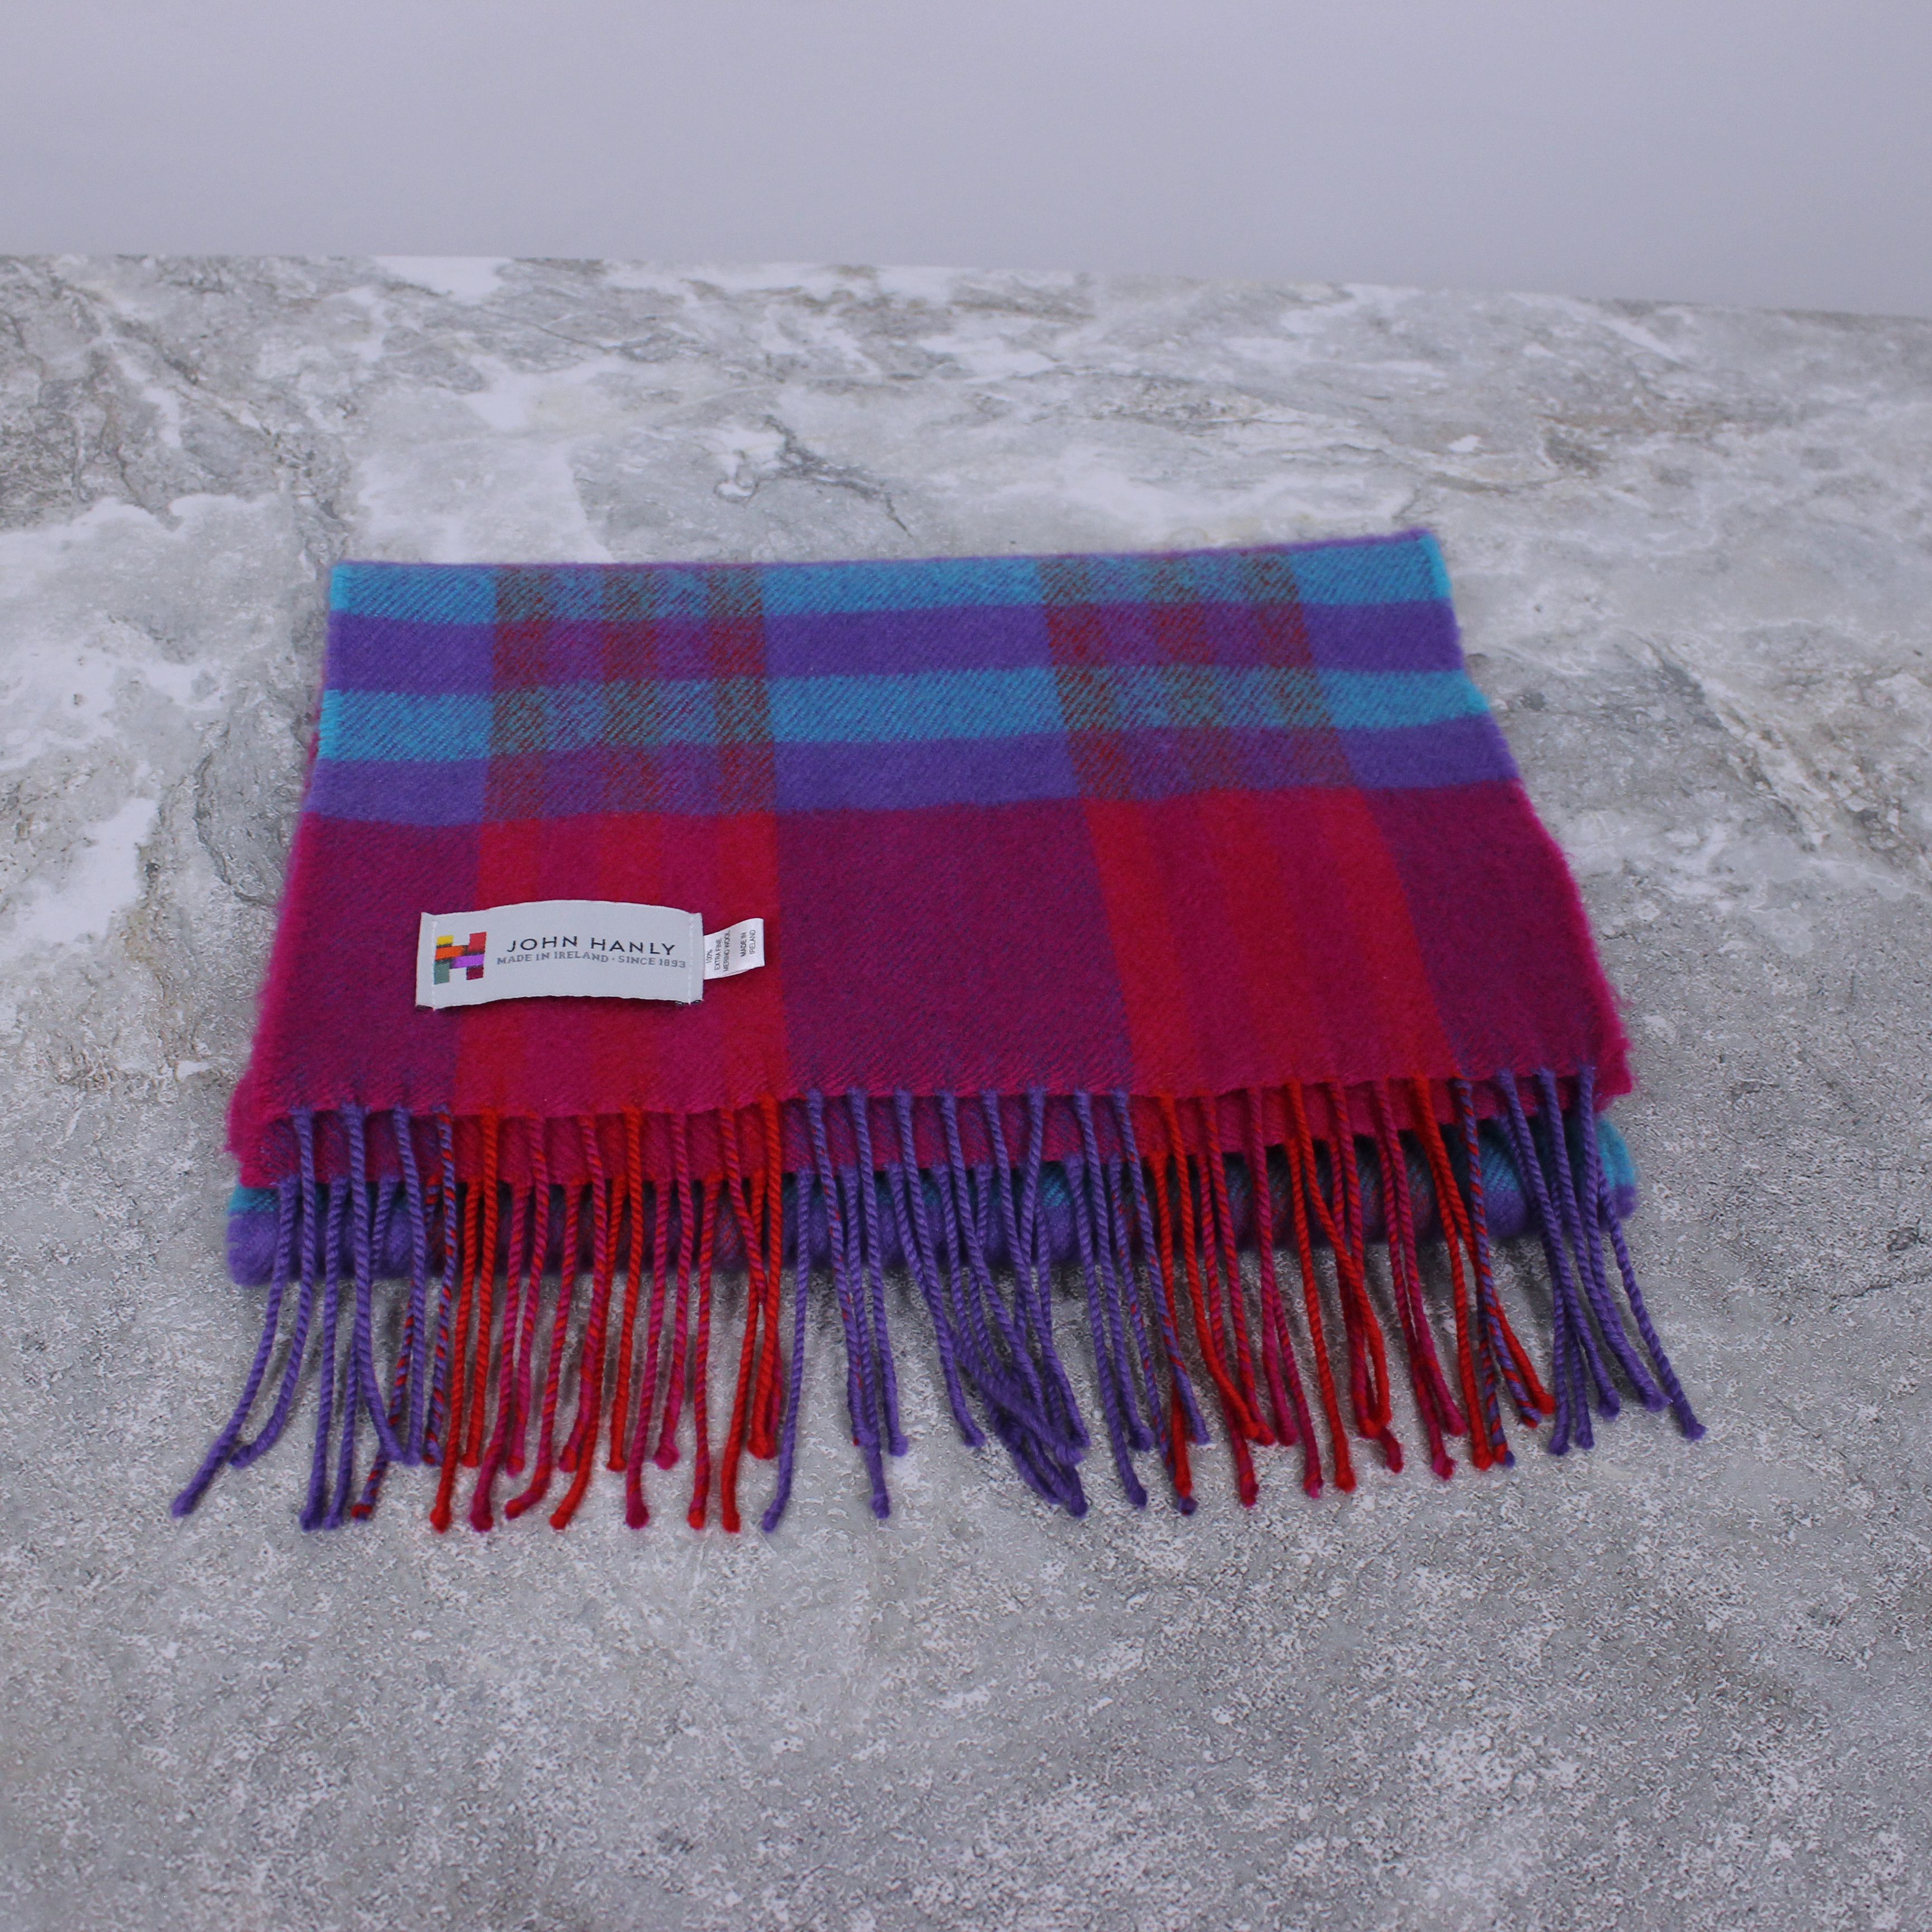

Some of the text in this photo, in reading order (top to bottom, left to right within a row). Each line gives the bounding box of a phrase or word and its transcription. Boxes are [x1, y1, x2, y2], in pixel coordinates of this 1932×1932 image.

[506, 936, 675, 955] JOHN HANLY
[497, 954, 533, 965] MADE
[554, 951, 609, 963] IRELAND
[617, 955, 656, 965] SINCE
[659, 958, 686, 968] 1893
